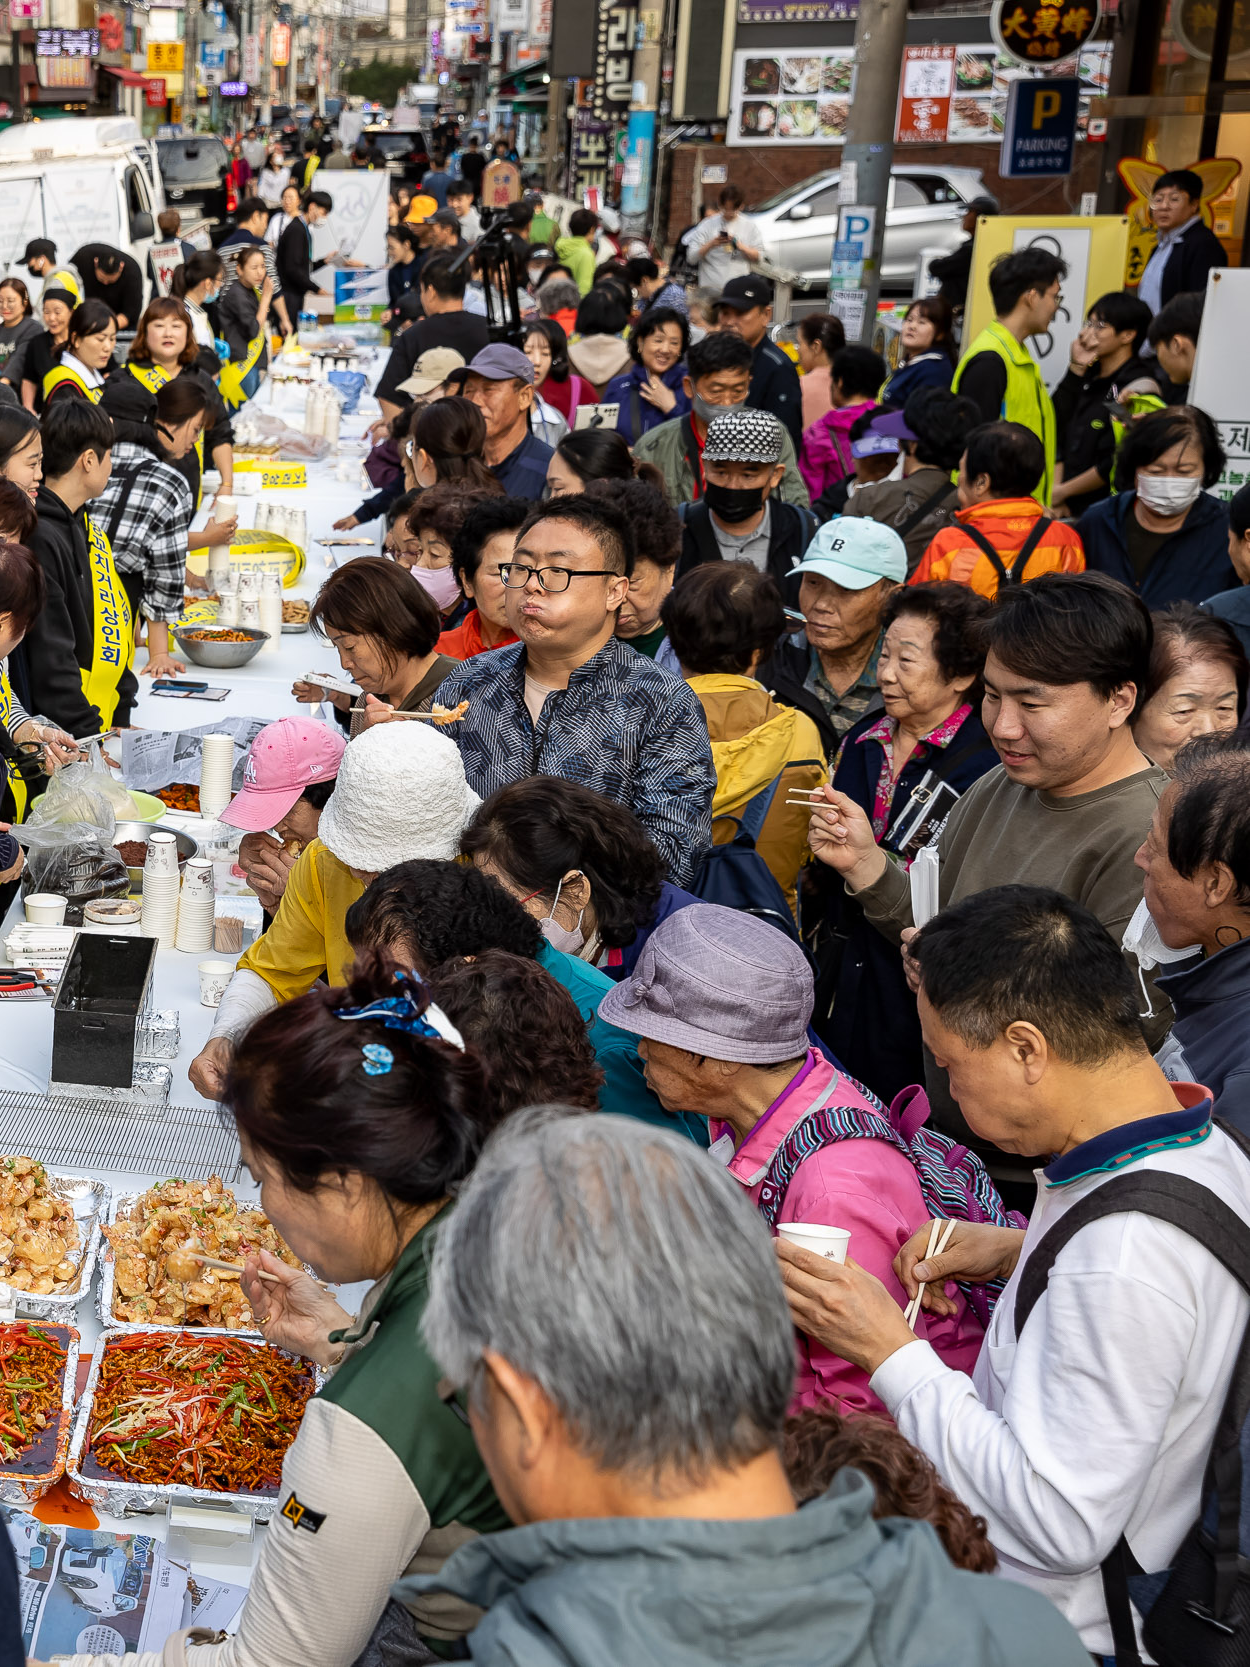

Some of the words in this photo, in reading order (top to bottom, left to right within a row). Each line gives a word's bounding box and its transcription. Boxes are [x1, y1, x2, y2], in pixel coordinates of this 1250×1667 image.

[1032, 89, 1062, 130] P
[1016, 137, 1069, 152] PARKING
[845, 215, 870, 242] P
